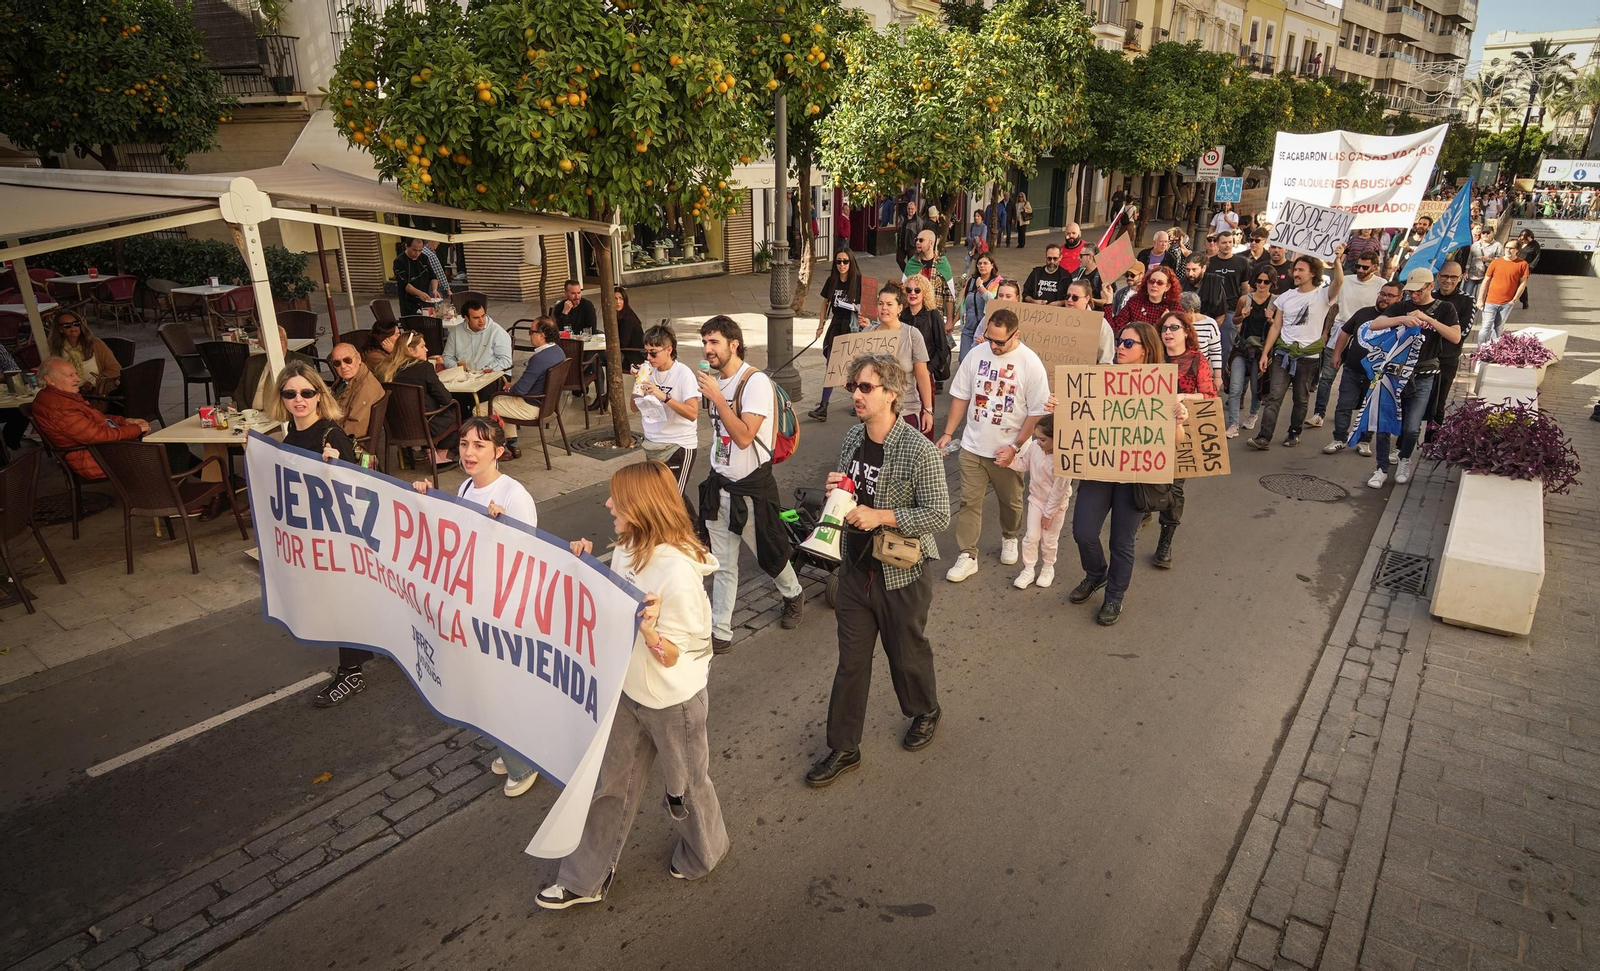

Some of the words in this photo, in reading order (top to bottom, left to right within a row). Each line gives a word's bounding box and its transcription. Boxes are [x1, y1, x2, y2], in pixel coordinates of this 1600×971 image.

[1279, 151, 1286, 160] SE
[1286, 151, 1328, 161] ACABARON
[1328, 151, 1346, 161] LAS
[1348, 151, 1388, 162] CASAS
[1283, 177, 1297, 187] LOS
[1065, 315, 1081, 328] OS
[1067, 372, 1097, 398] MI
[1104, 367, 1173, 397] RIÑÓN
[1070, 400, 1096, 421] PA
[1102, 398, 1168, 422] PAGAR
[1193, 401, 1217, 419] NI
[1058, 429, 1084, 450] LA
[1088, 426, 1166, 450] ENTRADA
[1197, 423, 1222, 472] CASAS
[1061, 453, 1084, 473] DE
[1089, 450, 1115, 467] UN
[1119, 450, 1166, 472] PISO
[269, 463, 381, 553] JEREZ
[391, 499, 478, 606] PARA
[492, 542, 597, 668] VIVIR
[274, 526, 306, 569] POR
[311, 537, 347, 573] EL
[423, 592, 436, 630] A
[437, 600, 468, 648] LA
[471, 616, 598, 724] VIVIENDA
